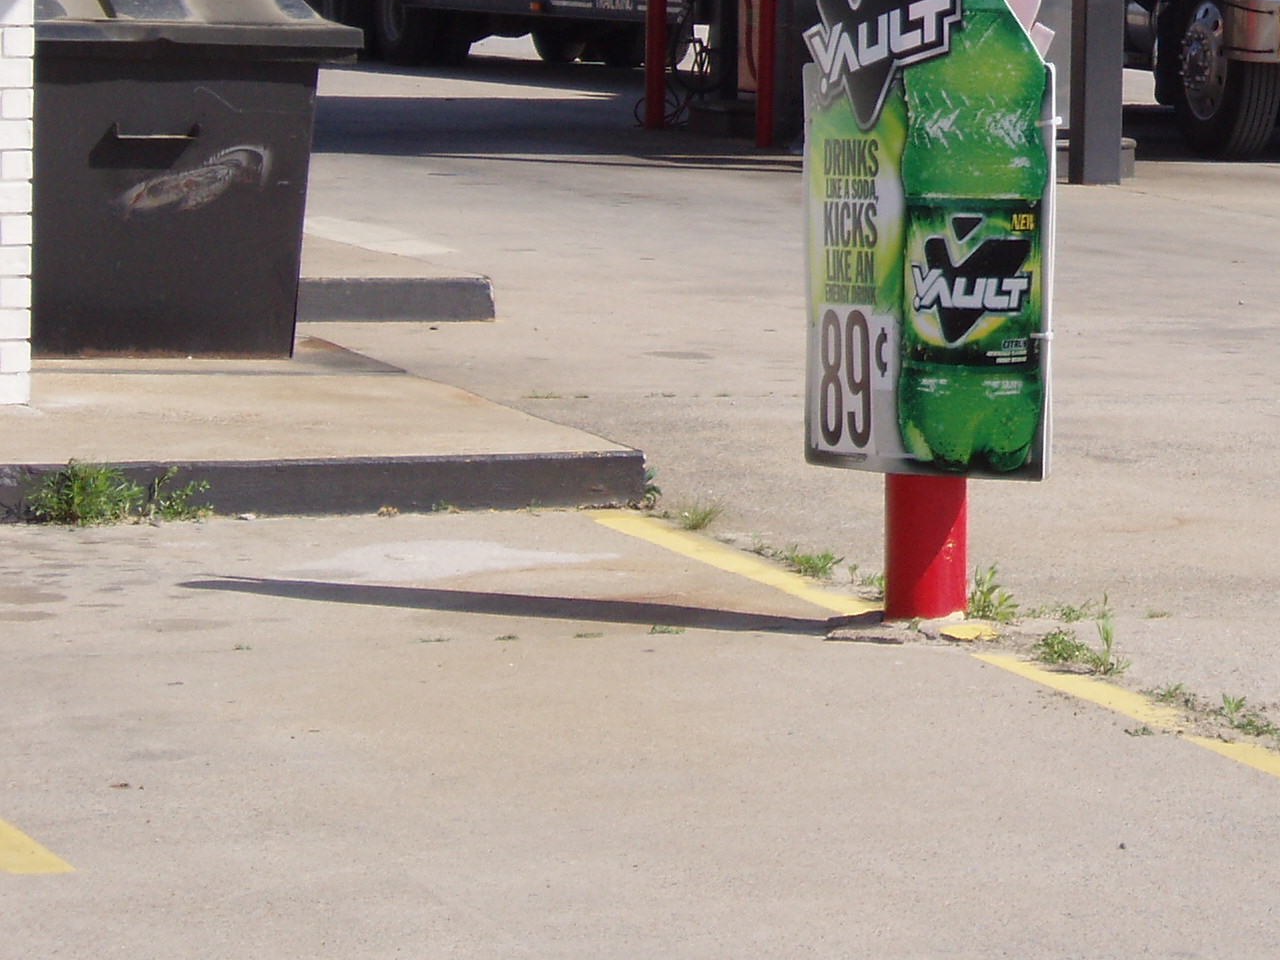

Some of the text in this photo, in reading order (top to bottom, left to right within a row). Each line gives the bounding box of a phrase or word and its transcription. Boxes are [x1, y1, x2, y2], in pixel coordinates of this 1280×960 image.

[824, 139, 880, 177] DRINKS
[826, 176, 842, 198] LIKE
[844, 178, 850, 199] A
[824, 200, 878, 248] KICKS
[826, 248, 875, 283] LIKE AN
[911, 265, 1030, 311] VAULT
